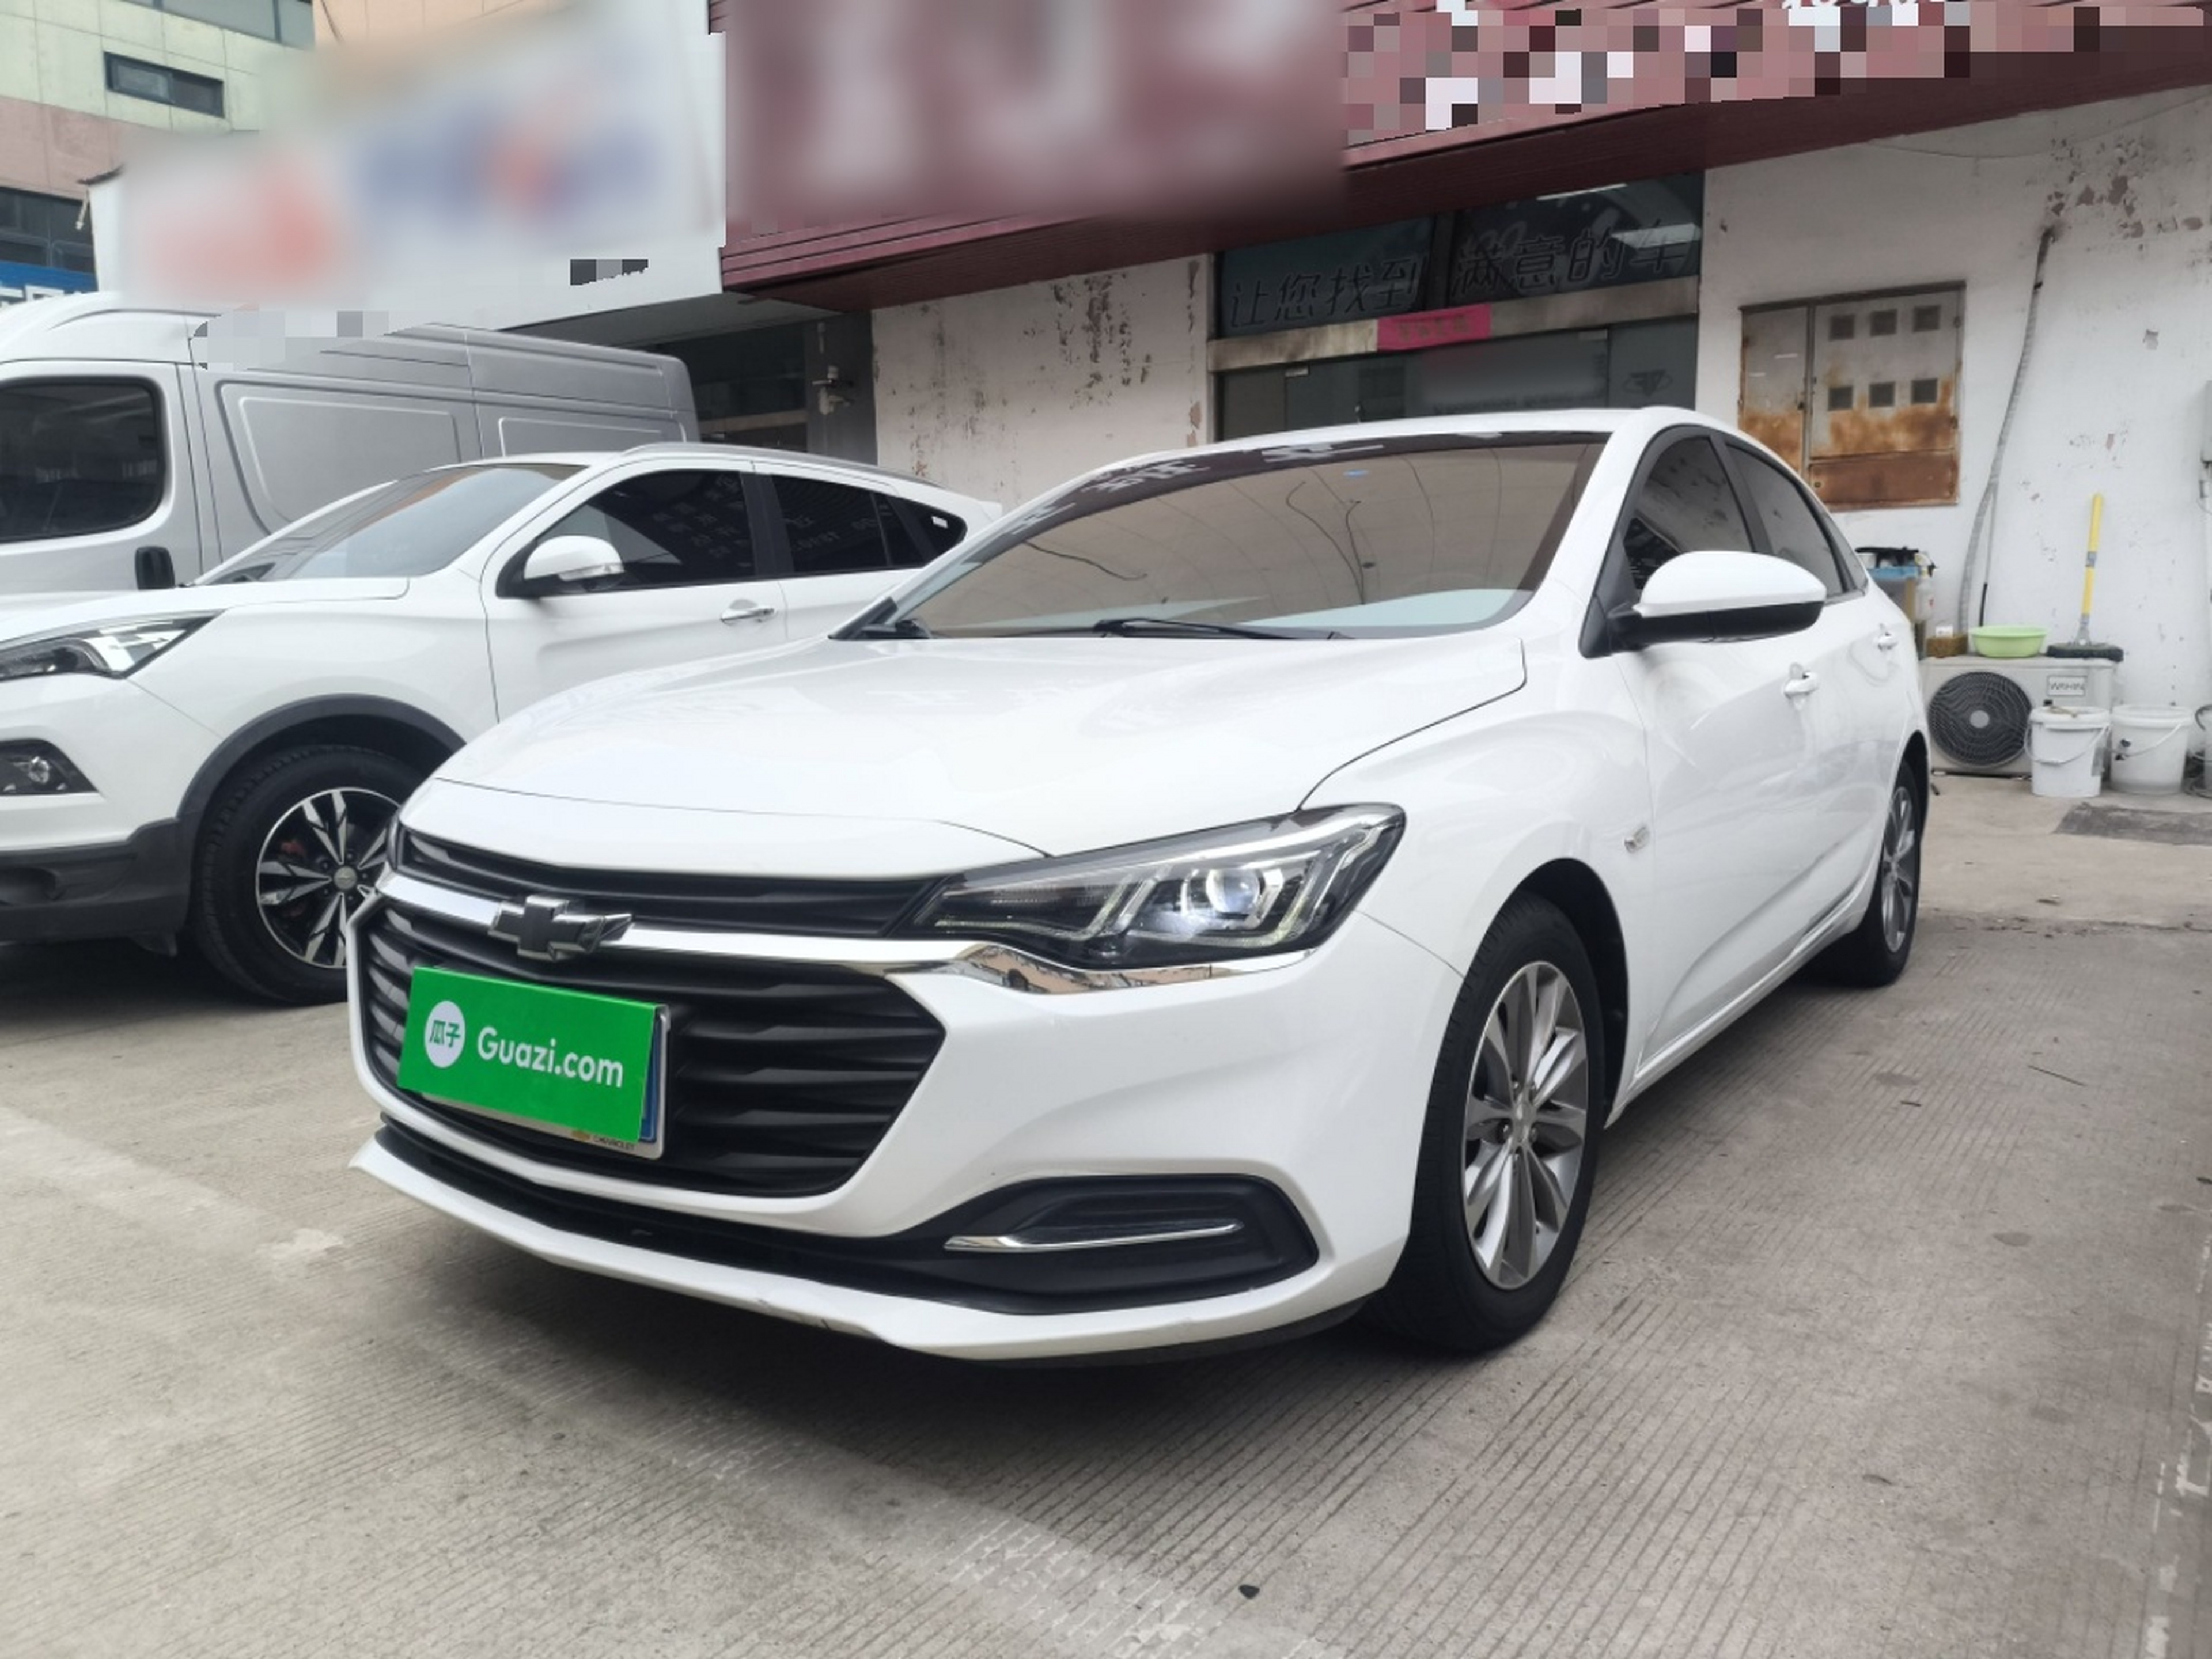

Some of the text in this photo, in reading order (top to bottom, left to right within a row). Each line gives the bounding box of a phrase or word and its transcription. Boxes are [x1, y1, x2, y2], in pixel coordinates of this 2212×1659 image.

[1230, 257, 1419, 329] 让您找到
[429, 1019, 460, 1048] 瓜子
[478, 1025, 623, 1088] Guazi.com
